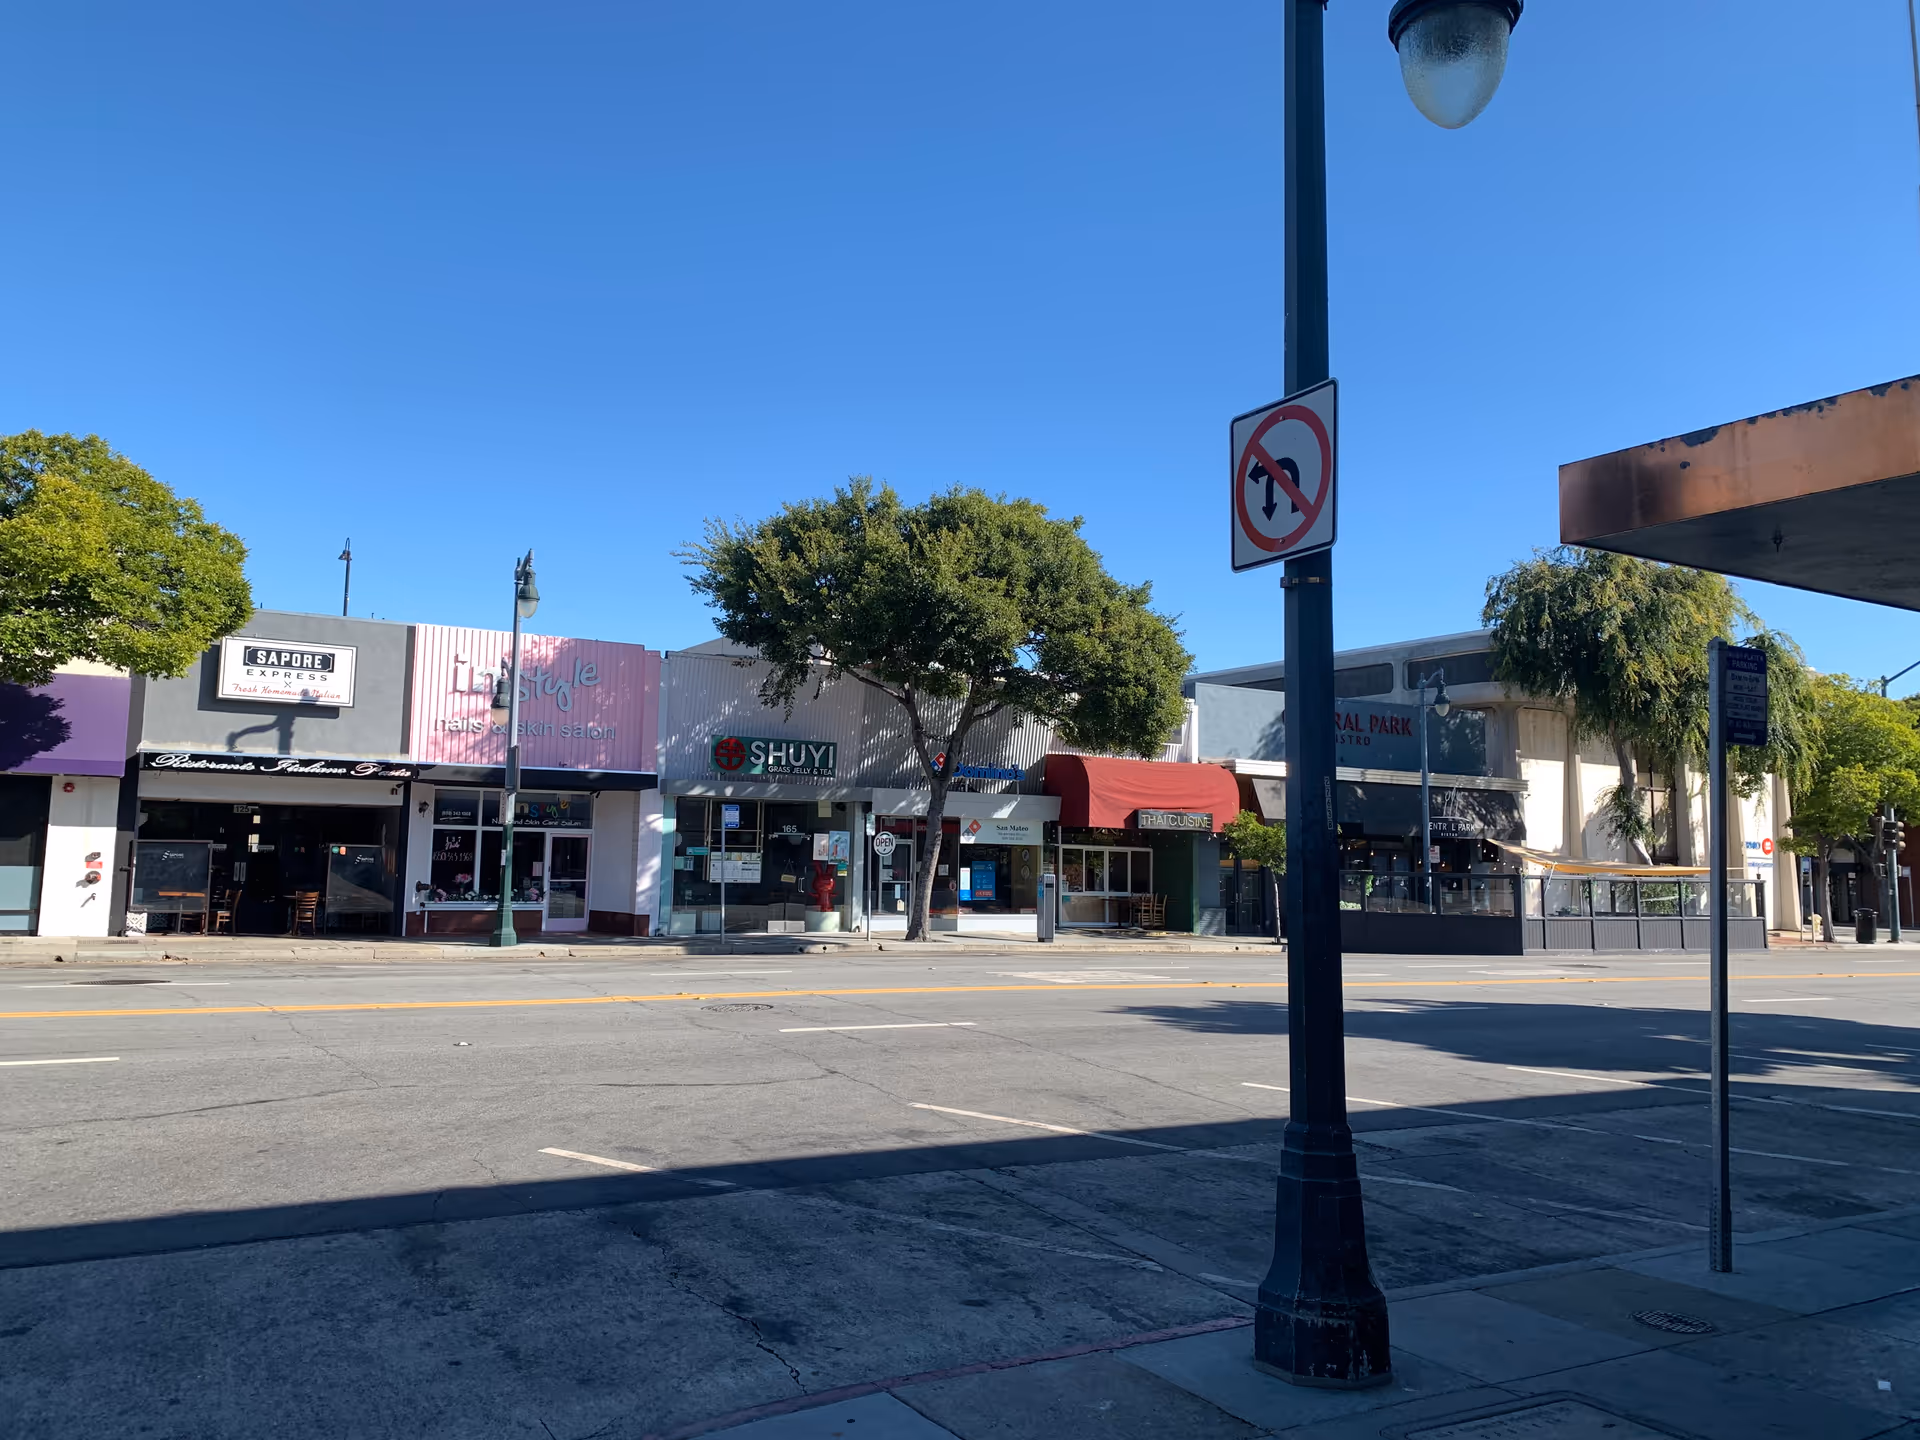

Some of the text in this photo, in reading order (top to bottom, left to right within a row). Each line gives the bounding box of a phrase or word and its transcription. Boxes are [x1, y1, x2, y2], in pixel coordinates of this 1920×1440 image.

[256, 650, 323, 669] SAPORE
[246, 668, 328, 681] EXPRESS
[231, 682, 341, 700] Fresh Homemade Italian
[434, 717, 485, 733] nails
[516, 720, 556, 736] skin
[559, 722, 616, 740] salon
[1369, 713, 1413, 737] PARK
[1335, 734, 1371, 746] ISTRO
[749, 740, 834, 768] SHUYI
[350, 762, 412, 778] Pasta
[782, 825, 797, 833] 165
[1142, 814, 1212, 829] THAI CUISINE
[1429, 821, 1476, 831] ENTRL PARK
[875, 837, 894, 847] OPEN
